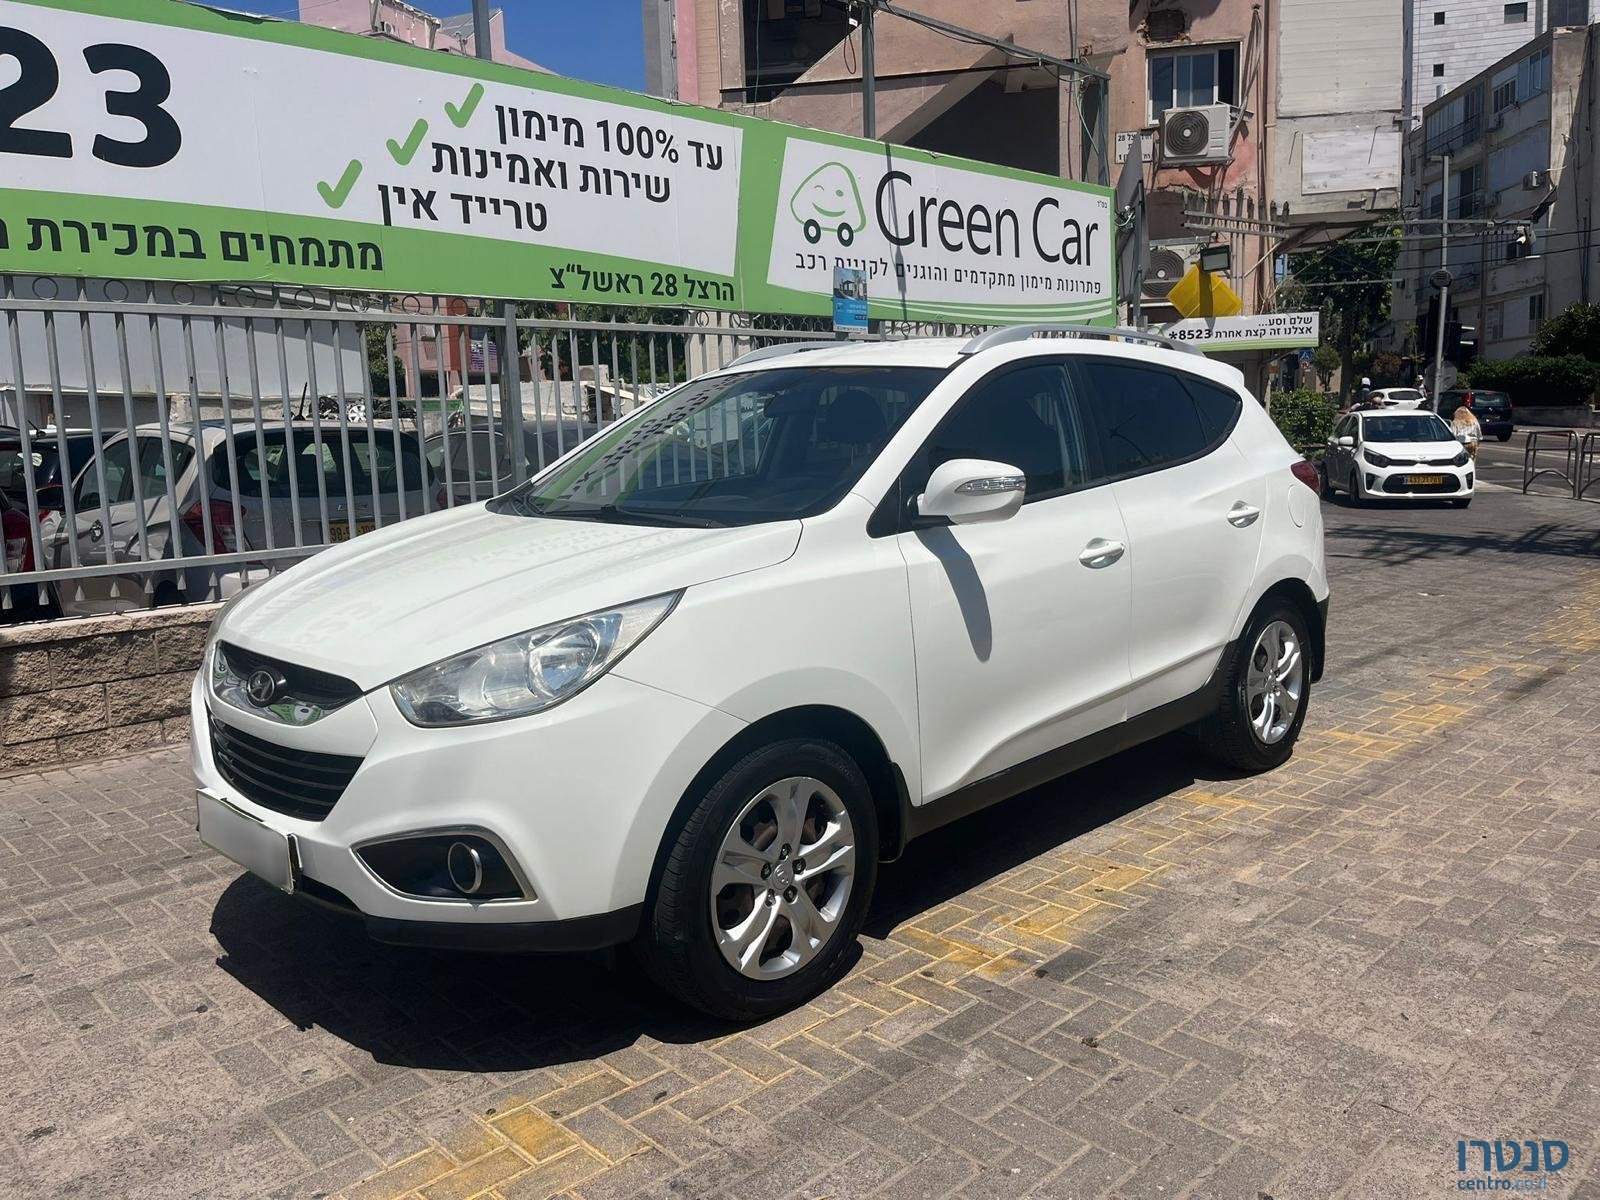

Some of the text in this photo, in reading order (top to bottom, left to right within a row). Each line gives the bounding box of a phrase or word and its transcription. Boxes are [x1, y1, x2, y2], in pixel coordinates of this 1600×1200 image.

[494, 104, 723, 170] עד 100% מימון
[431, 141, 671, 203] שירות ואמינות
[377, 183, 548, 232] טרייד אין
[875, 170, 1099, 267] Green Car
[26, 217, 206, 260] במכירת
[220, 230, 384, 272] מתמחים
[795, 252, 827, 271] רכב
[895, 263, 948, 282] והוגנים
[954, 269, 1015, 290] מתקדמים
[650, 272, 678, 297] 28
[683, 273, 735, 302] הרצל
[1020, 274, 1052, 292] מימון
[1056, 278, 1101, 295] פתרונות
[1284, 325, 1313, 335] אצלנו
[1289, 315, 1313, 326] שלם
[1215, 329, 1242, 339] אחרת
[1244, 328, 1267, 338] קצת
[1269, 328, 1281, 336] זה
